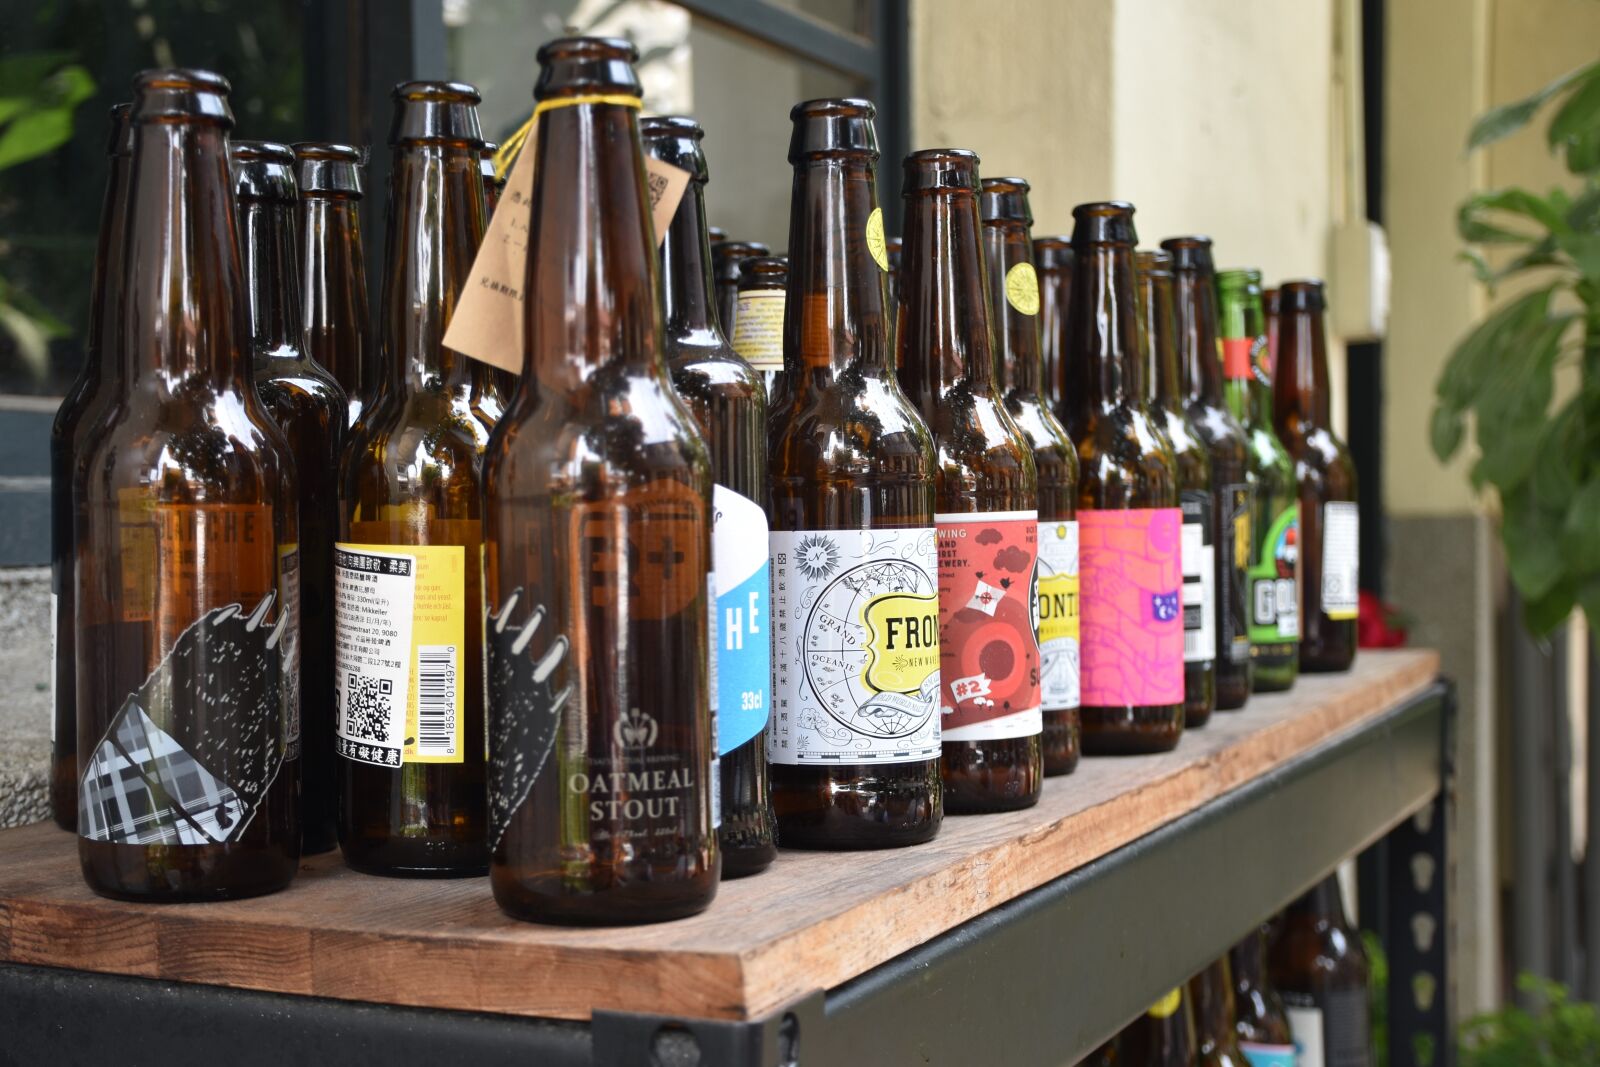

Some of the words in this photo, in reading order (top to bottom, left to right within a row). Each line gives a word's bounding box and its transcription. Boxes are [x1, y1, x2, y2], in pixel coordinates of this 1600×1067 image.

[819, 614, 856, 645] GRAND
[812, 653, 856, 673] OCEANIE
[446, 663, 455, 698] 01497
[956, 680, 982, 697] #2
[741, 688, 763, 711] 33cl
[446, 702, 455, 736] 18534
[568, 767, 694, 794] OATMEAL
[590, 796, 679, 821] STOUT
